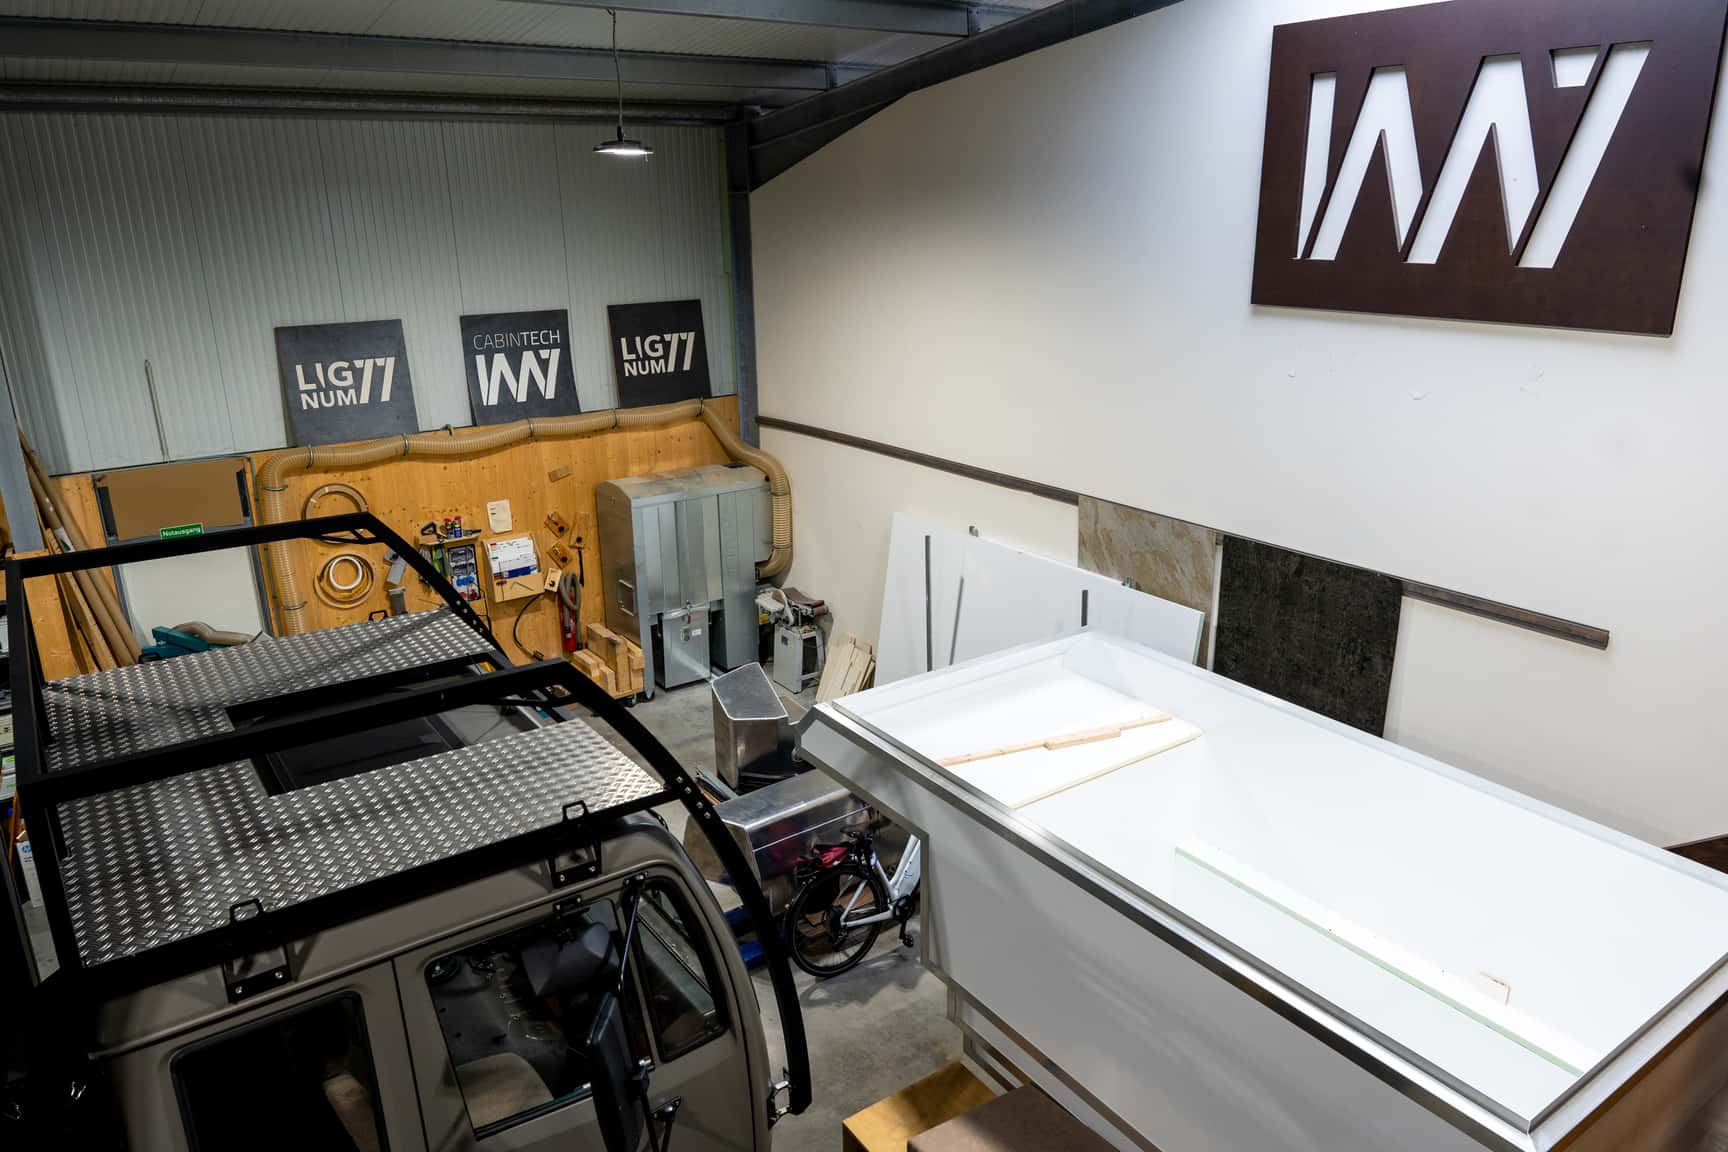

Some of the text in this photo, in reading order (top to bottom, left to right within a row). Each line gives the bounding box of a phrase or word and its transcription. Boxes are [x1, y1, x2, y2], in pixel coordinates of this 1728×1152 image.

[473, 329, 561, 350] CABINTECH
[623, 358, 666, 377] NUM
[300, 388, 358, 410] NUM
